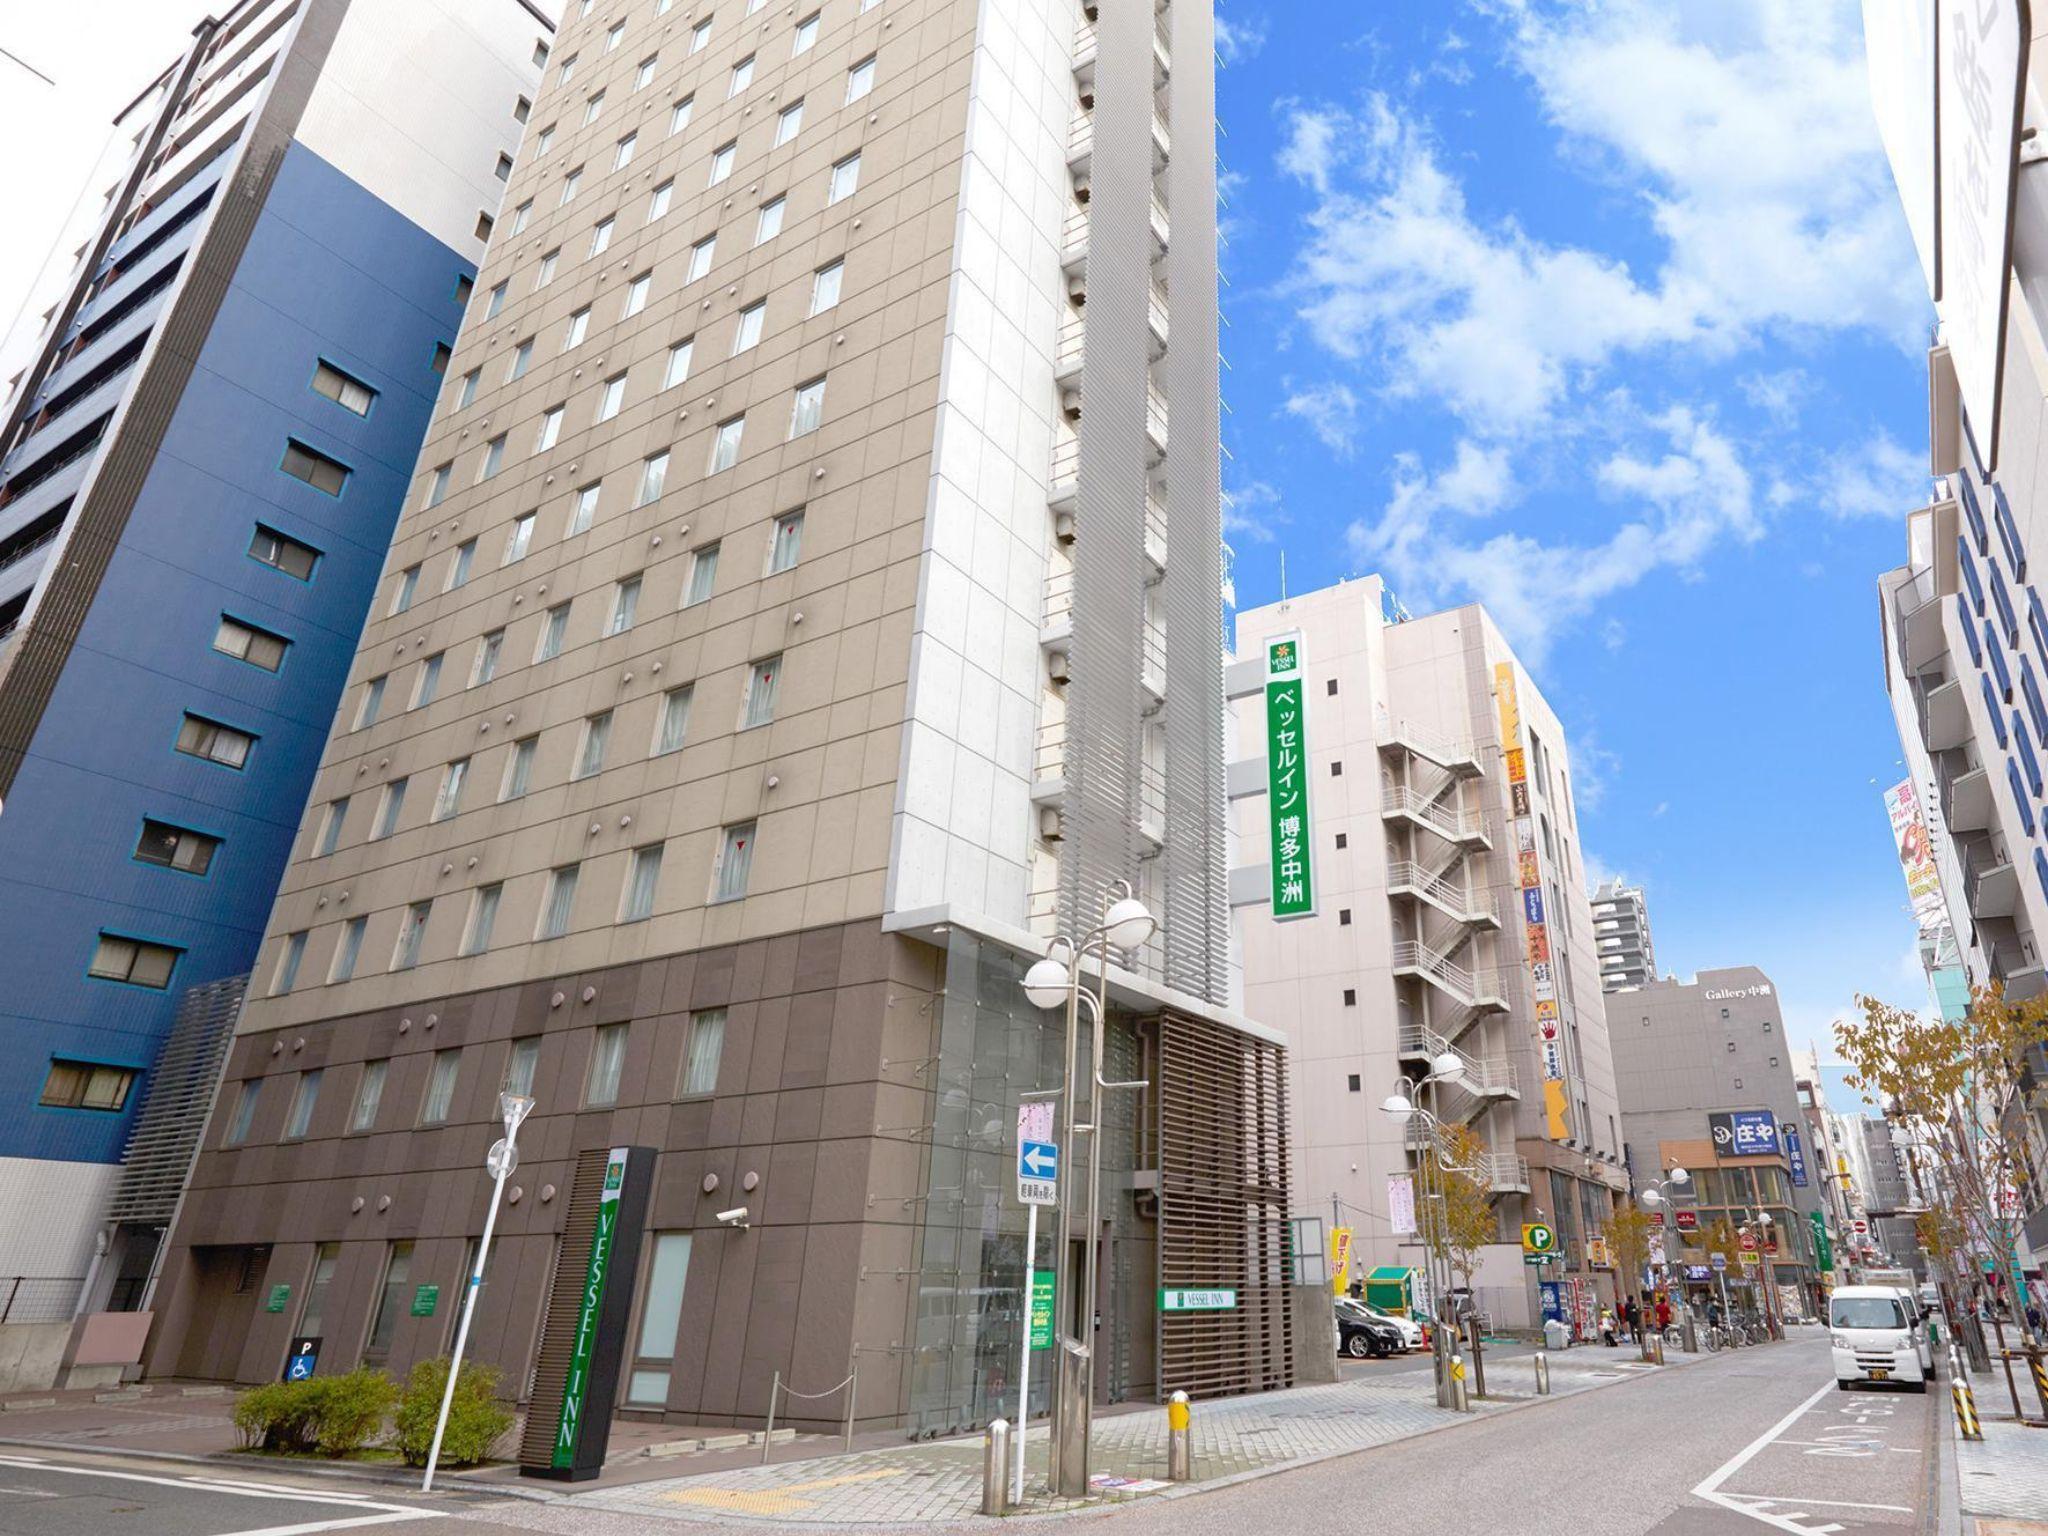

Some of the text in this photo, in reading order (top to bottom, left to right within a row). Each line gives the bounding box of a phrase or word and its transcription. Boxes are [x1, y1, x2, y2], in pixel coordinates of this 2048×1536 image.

[1274, 688, 1304, 905] ベッセルイン 博多中洲
[1705, 988, 1746, 1000] Gallery
[1736, 1122, 1775, 1144] 庄や
[1534, 1228, 1549, 1248] P
[1185, 1292, 1225, 1306] VESSEL INN
[558, 1213, 613, 1447] VESSEL INN
[301, 1342, 312, 1355] P
